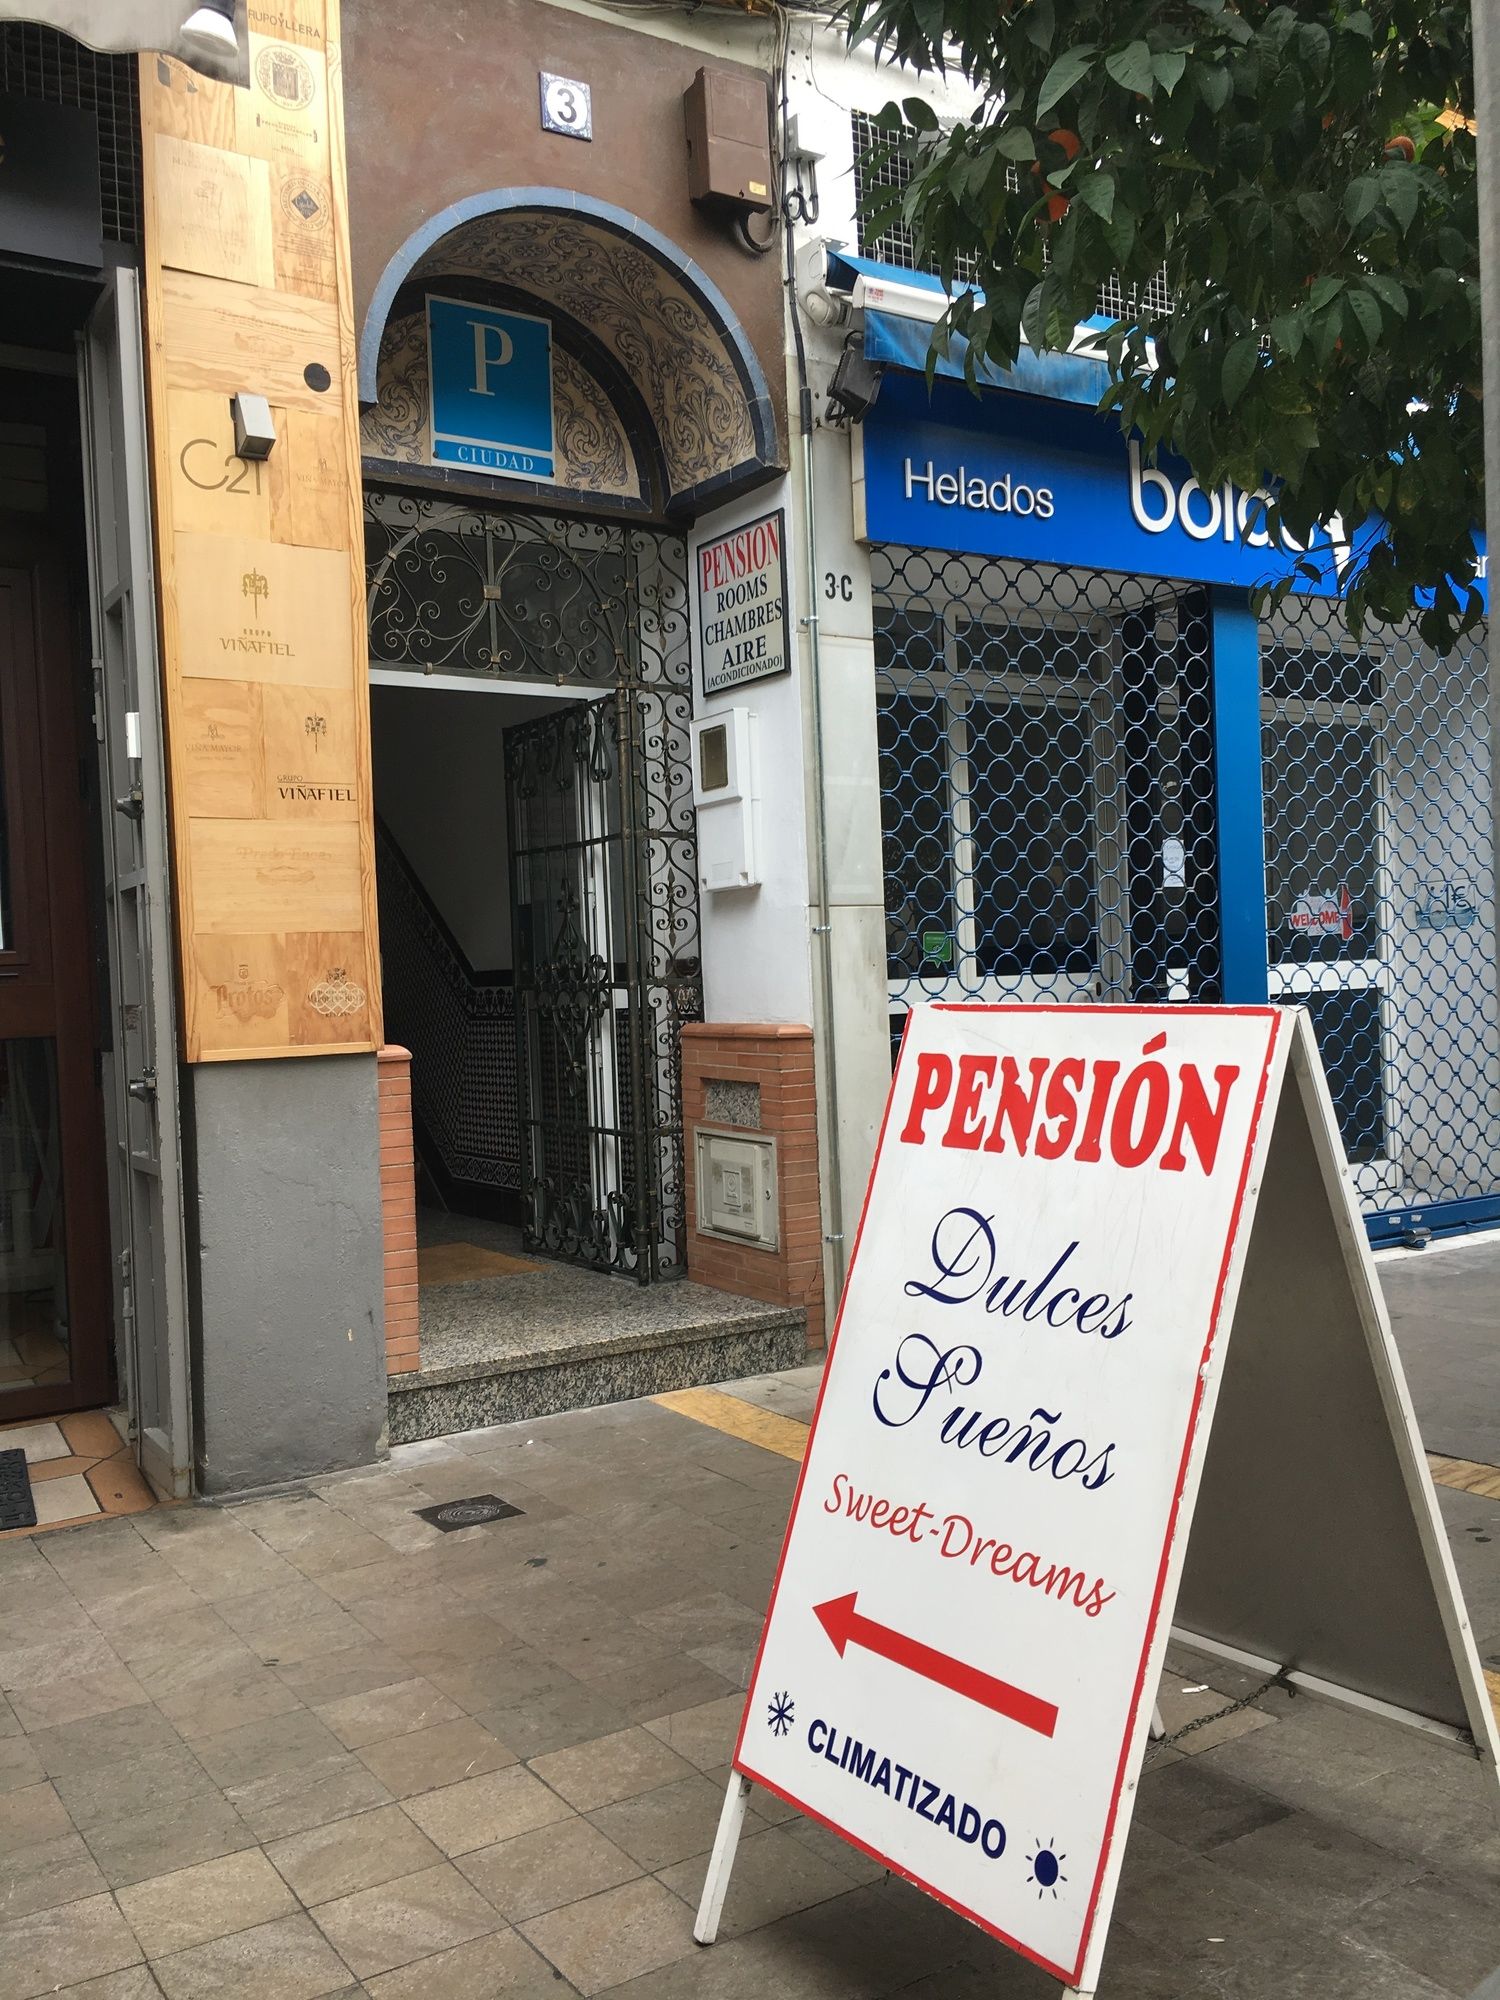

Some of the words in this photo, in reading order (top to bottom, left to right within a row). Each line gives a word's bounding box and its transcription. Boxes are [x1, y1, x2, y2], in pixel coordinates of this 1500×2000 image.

[557, 87, 577, 124] 3
[466, 320, 514, 397] P
[457, 445, 535, 472] CIUDAD
[904, 457, 1055, 518] Helados
[702, 513, 780, 593] PENSION
[716, 573, 768, 614] ROOMS
[704, 597, 783, 646] CHAMBRES
[219, 637, 296, 657] VIÑAFIEL
[707, 654, 783, 689] (ACONDICIONADO)
[721, 634, 767, 670] AIRE
[276, 774, 303, 783] GRUPO
[278, 784, 357, 802] VIÑAFIEL
[899, 1031, 1240, 1177] PENSIÓN
[904, 1206, 1134, 1340] Dulces
[872, 1333, 1117, 1491] Sueños
[823, 1474, 1117, 1617] Sweet-Dreams
[806, 1719, 1008, 1860] CLIMATIZADO
